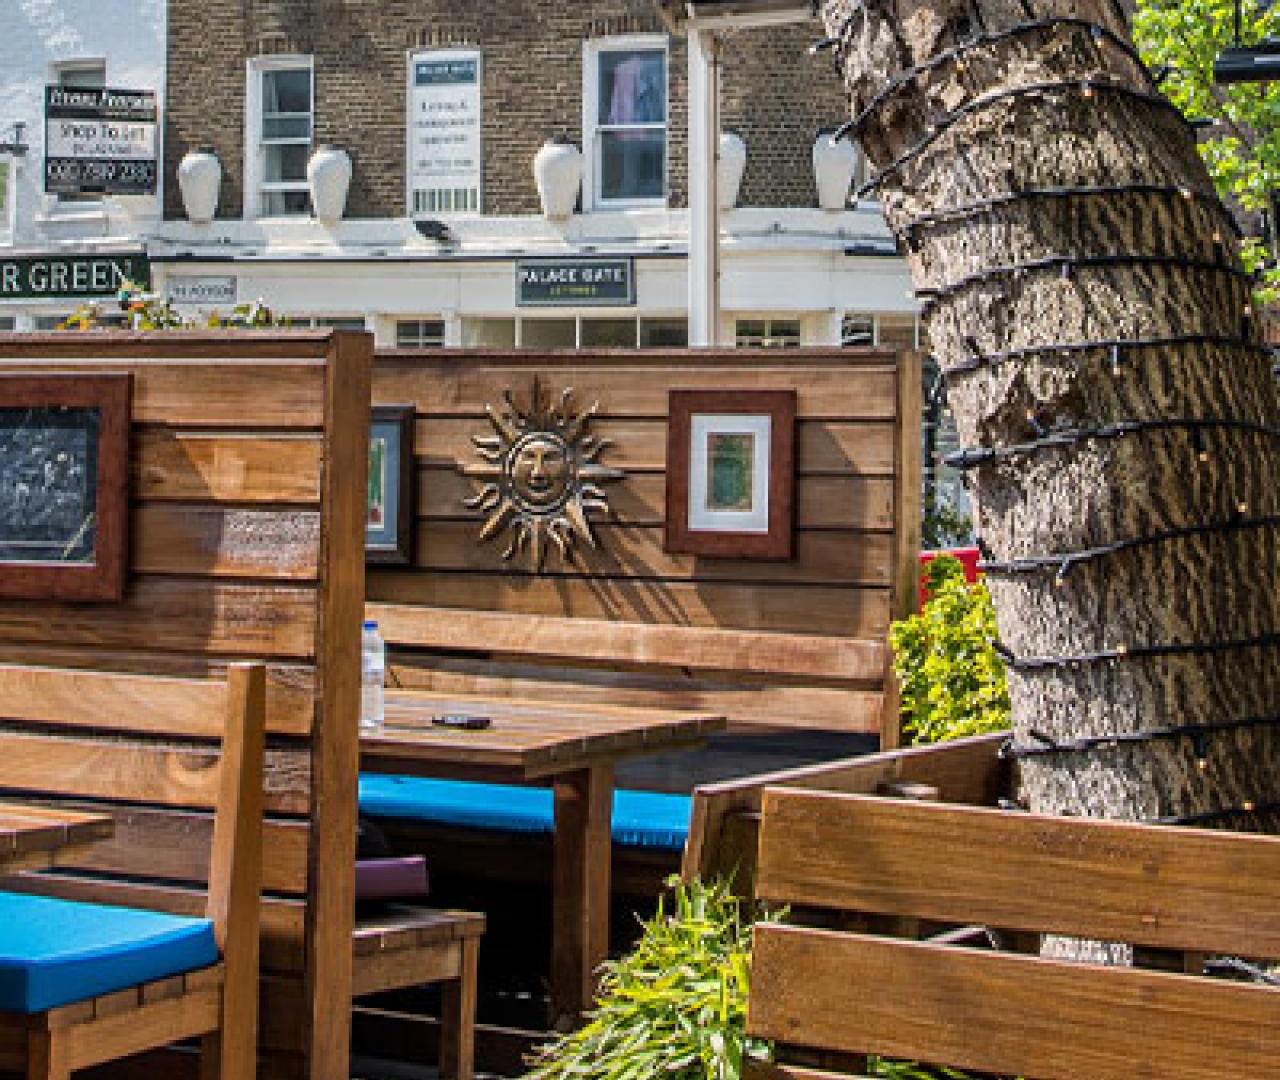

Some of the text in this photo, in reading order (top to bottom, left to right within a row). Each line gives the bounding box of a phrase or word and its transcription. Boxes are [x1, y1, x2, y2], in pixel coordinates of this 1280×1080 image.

[61, 124, 96, 140] Shop
[28, 260, 132, 293] GREEN
[518, 267, 623, 284] PALACE GATE
